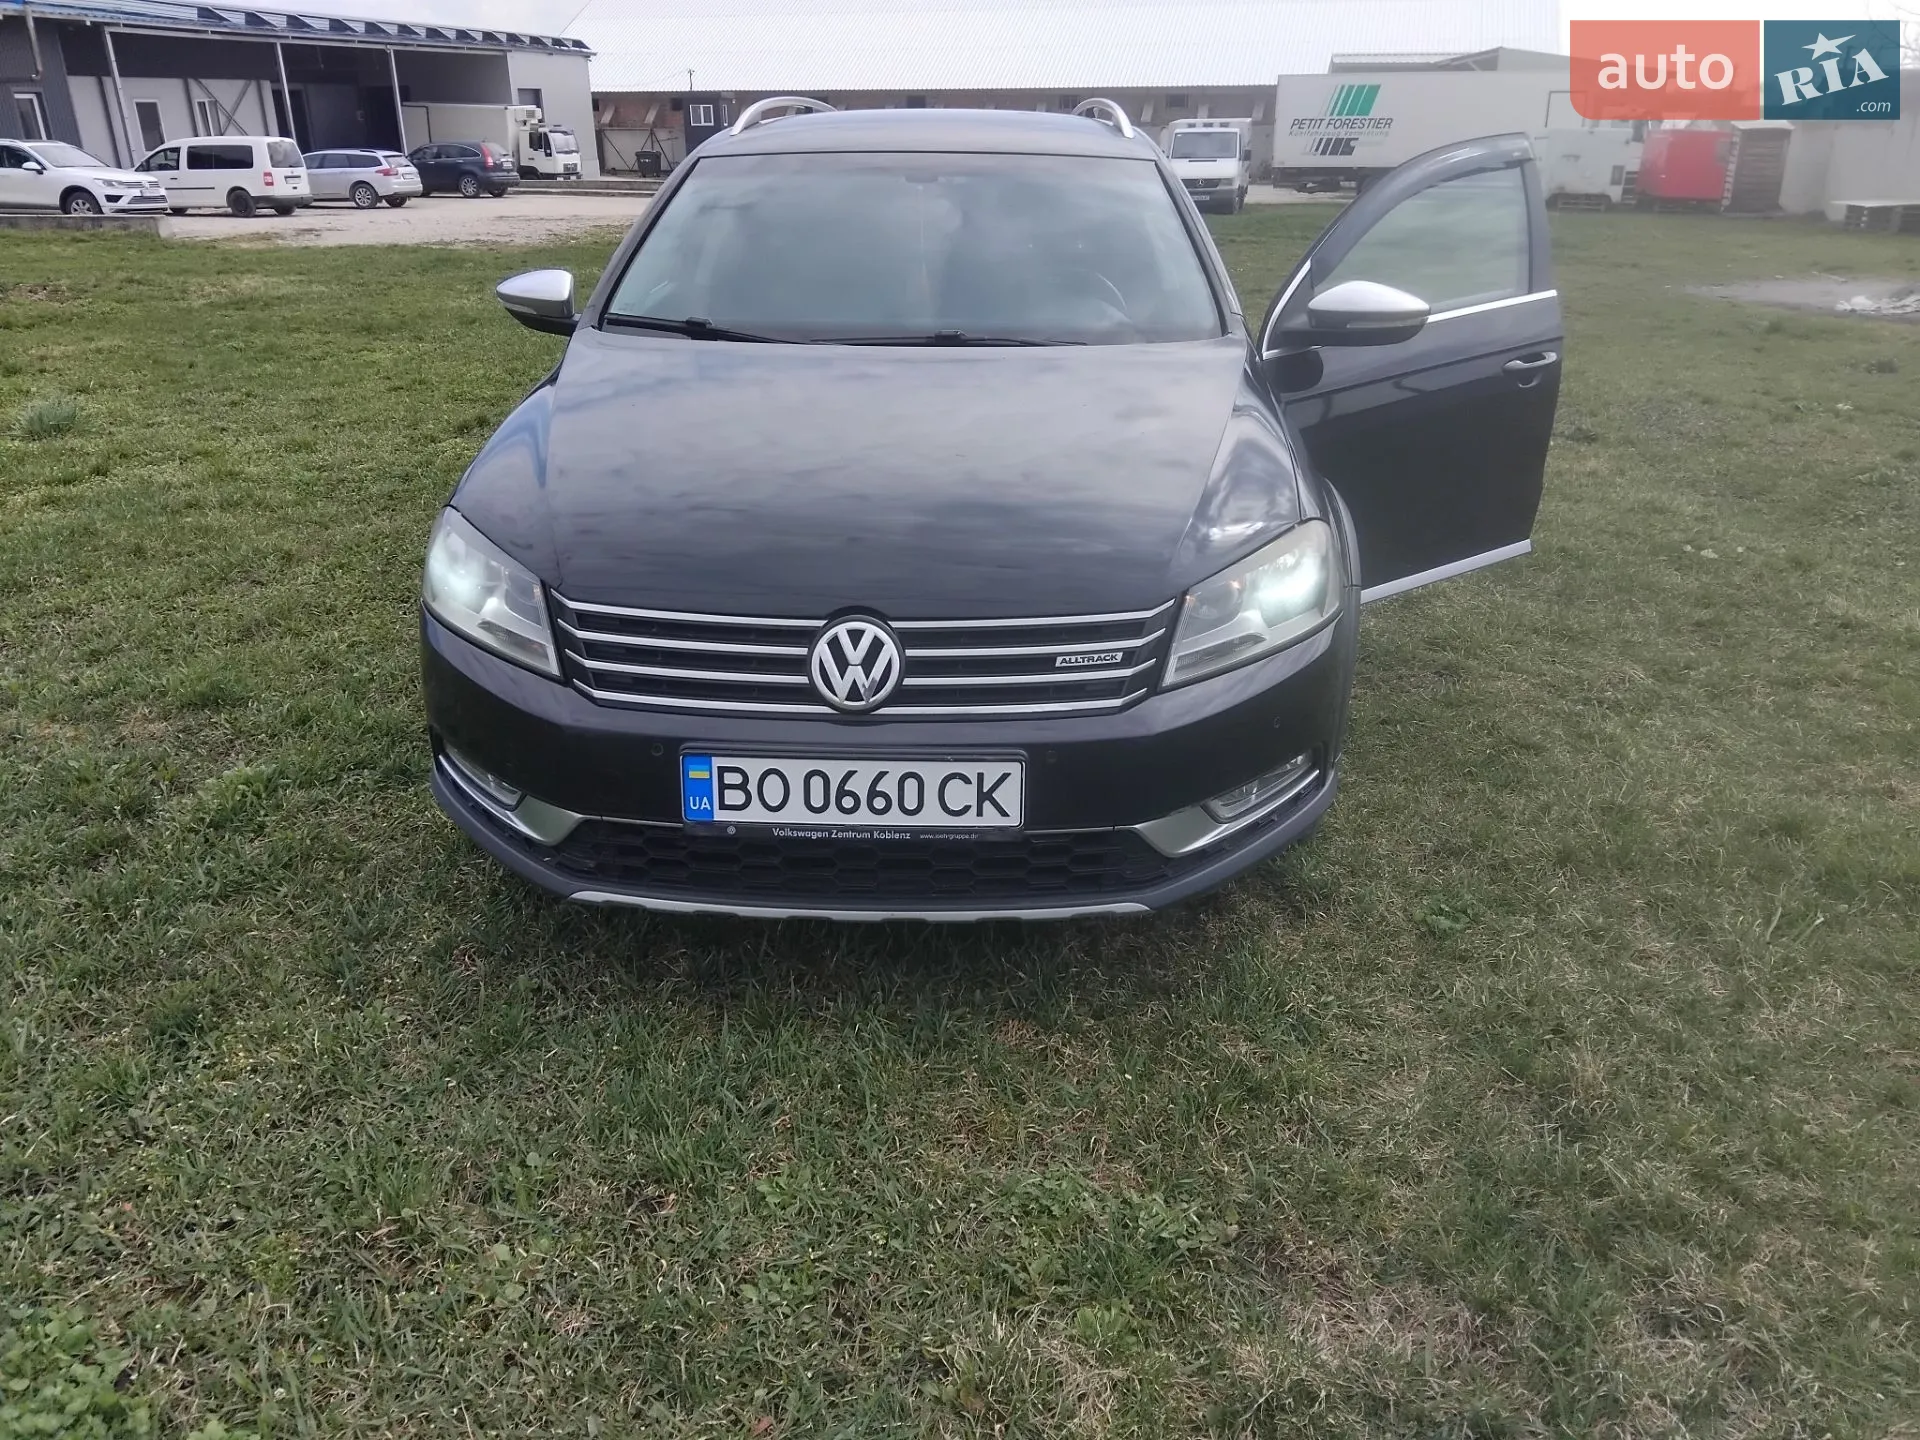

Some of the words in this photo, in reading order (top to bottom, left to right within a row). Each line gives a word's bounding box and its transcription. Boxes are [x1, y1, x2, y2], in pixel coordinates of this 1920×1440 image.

[1290, 118, 1326, 130] PETIT
[1326, 117, 1394, 130] FORESTIER
[1059, 654, 1119, 665] ALLTRACK
[689, 796, 711, 811] UA
[716, 765, 791, 813] BO
[803, 769, 925, 817] 0660
[937, 771, 1012, 818] CK
[772, 827, 829, 839] Volkswagen
[831, 829, 871, 839] Zentrum
[873, 830, 911, 839] Koblenz
